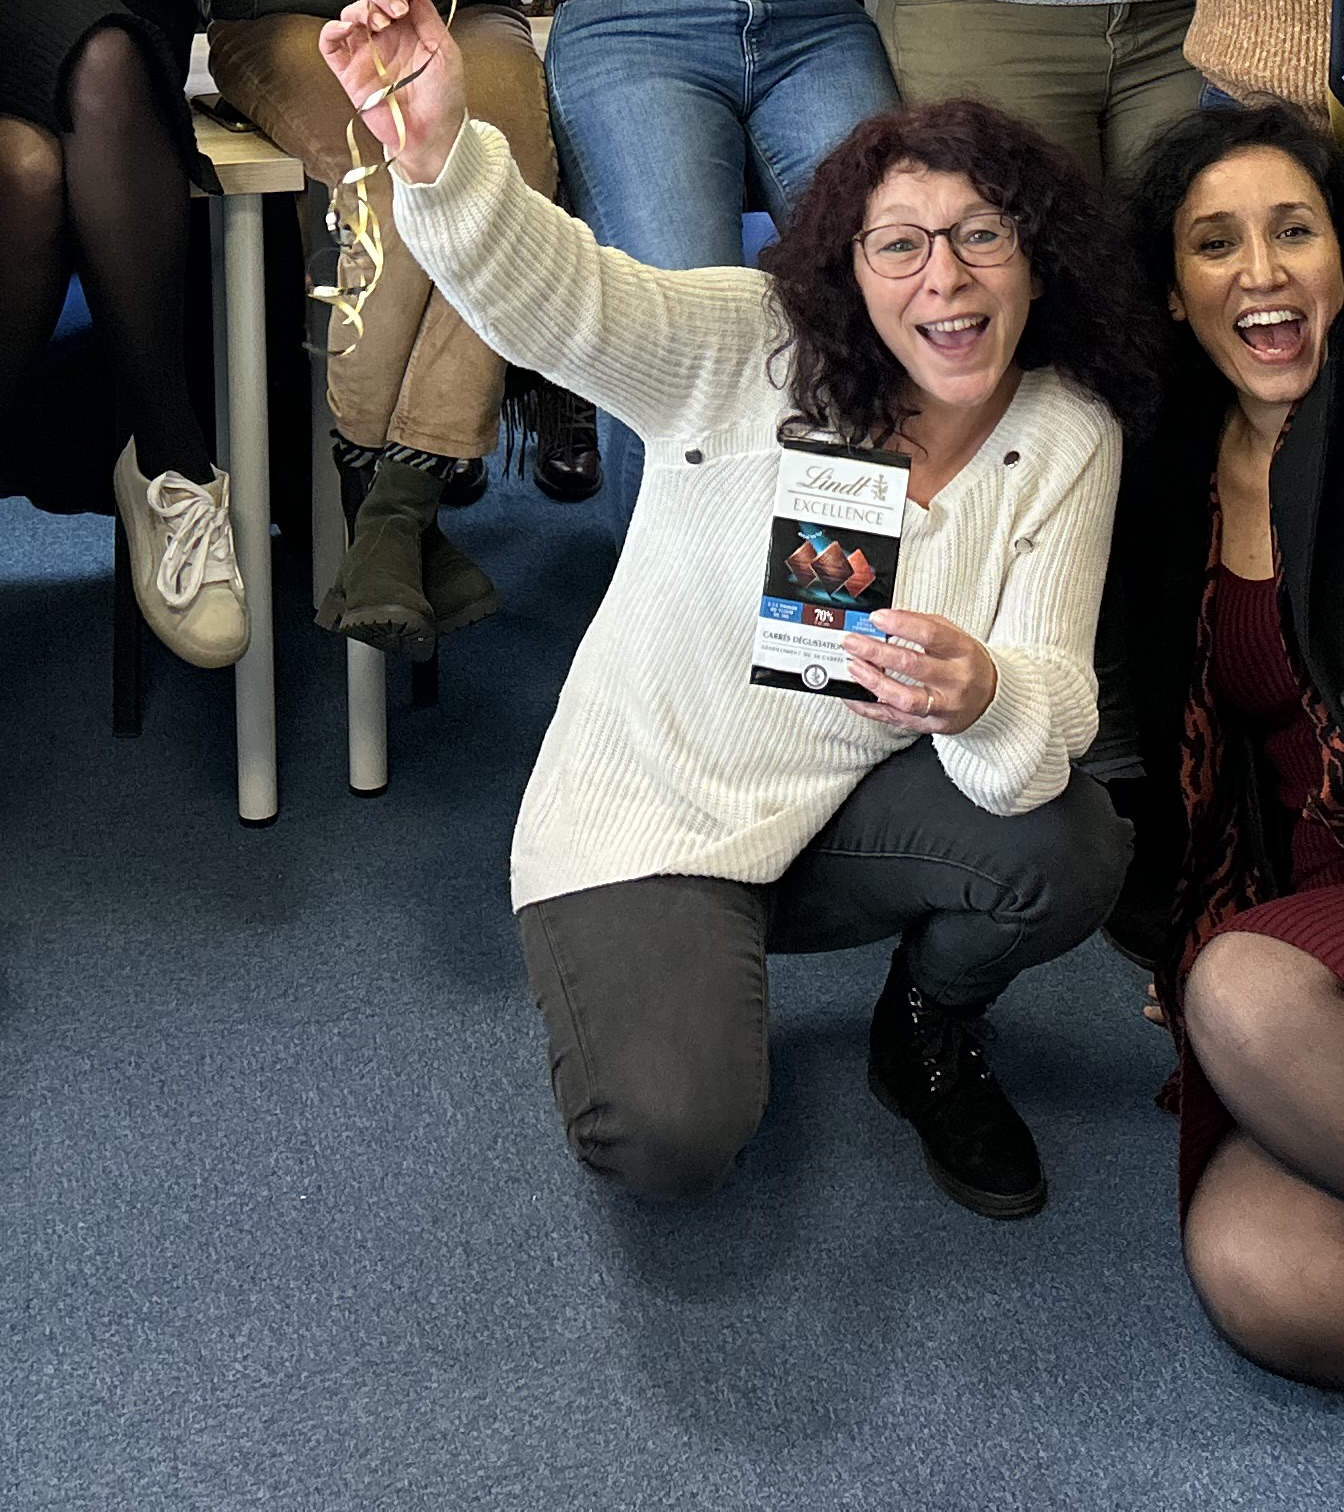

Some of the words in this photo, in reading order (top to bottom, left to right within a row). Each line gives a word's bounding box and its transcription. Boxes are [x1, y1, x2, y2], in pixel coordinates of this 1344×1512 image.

[796, 465, 872, 497] Lindt
[794, 498, 884, 525] EXCELLENCE
[814, 608, 834, 623] 70%
